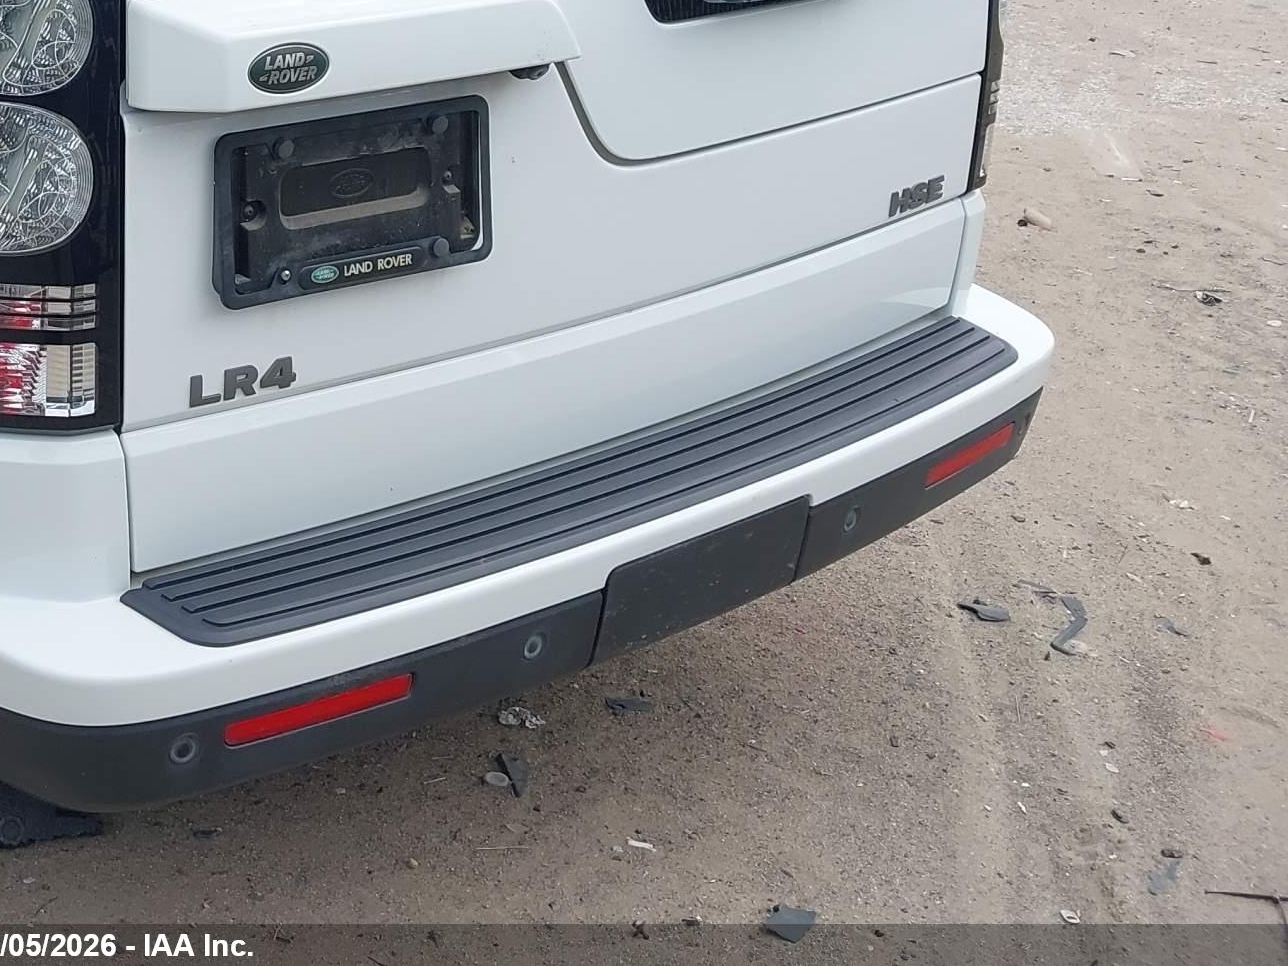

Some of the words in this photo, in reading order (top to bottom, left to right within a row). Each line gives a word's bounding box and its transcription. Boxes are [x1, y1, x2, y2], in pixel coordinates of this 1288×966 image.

[264, 51, 305, 71] LAND
[268, 65, 318, 86] ROVER
[888, 174, 945, 218] HSE
[343, 261, 374, 277] LAND
[377, 253, 413, 271] ROVER
[189, 356, 297, 408] LR4
